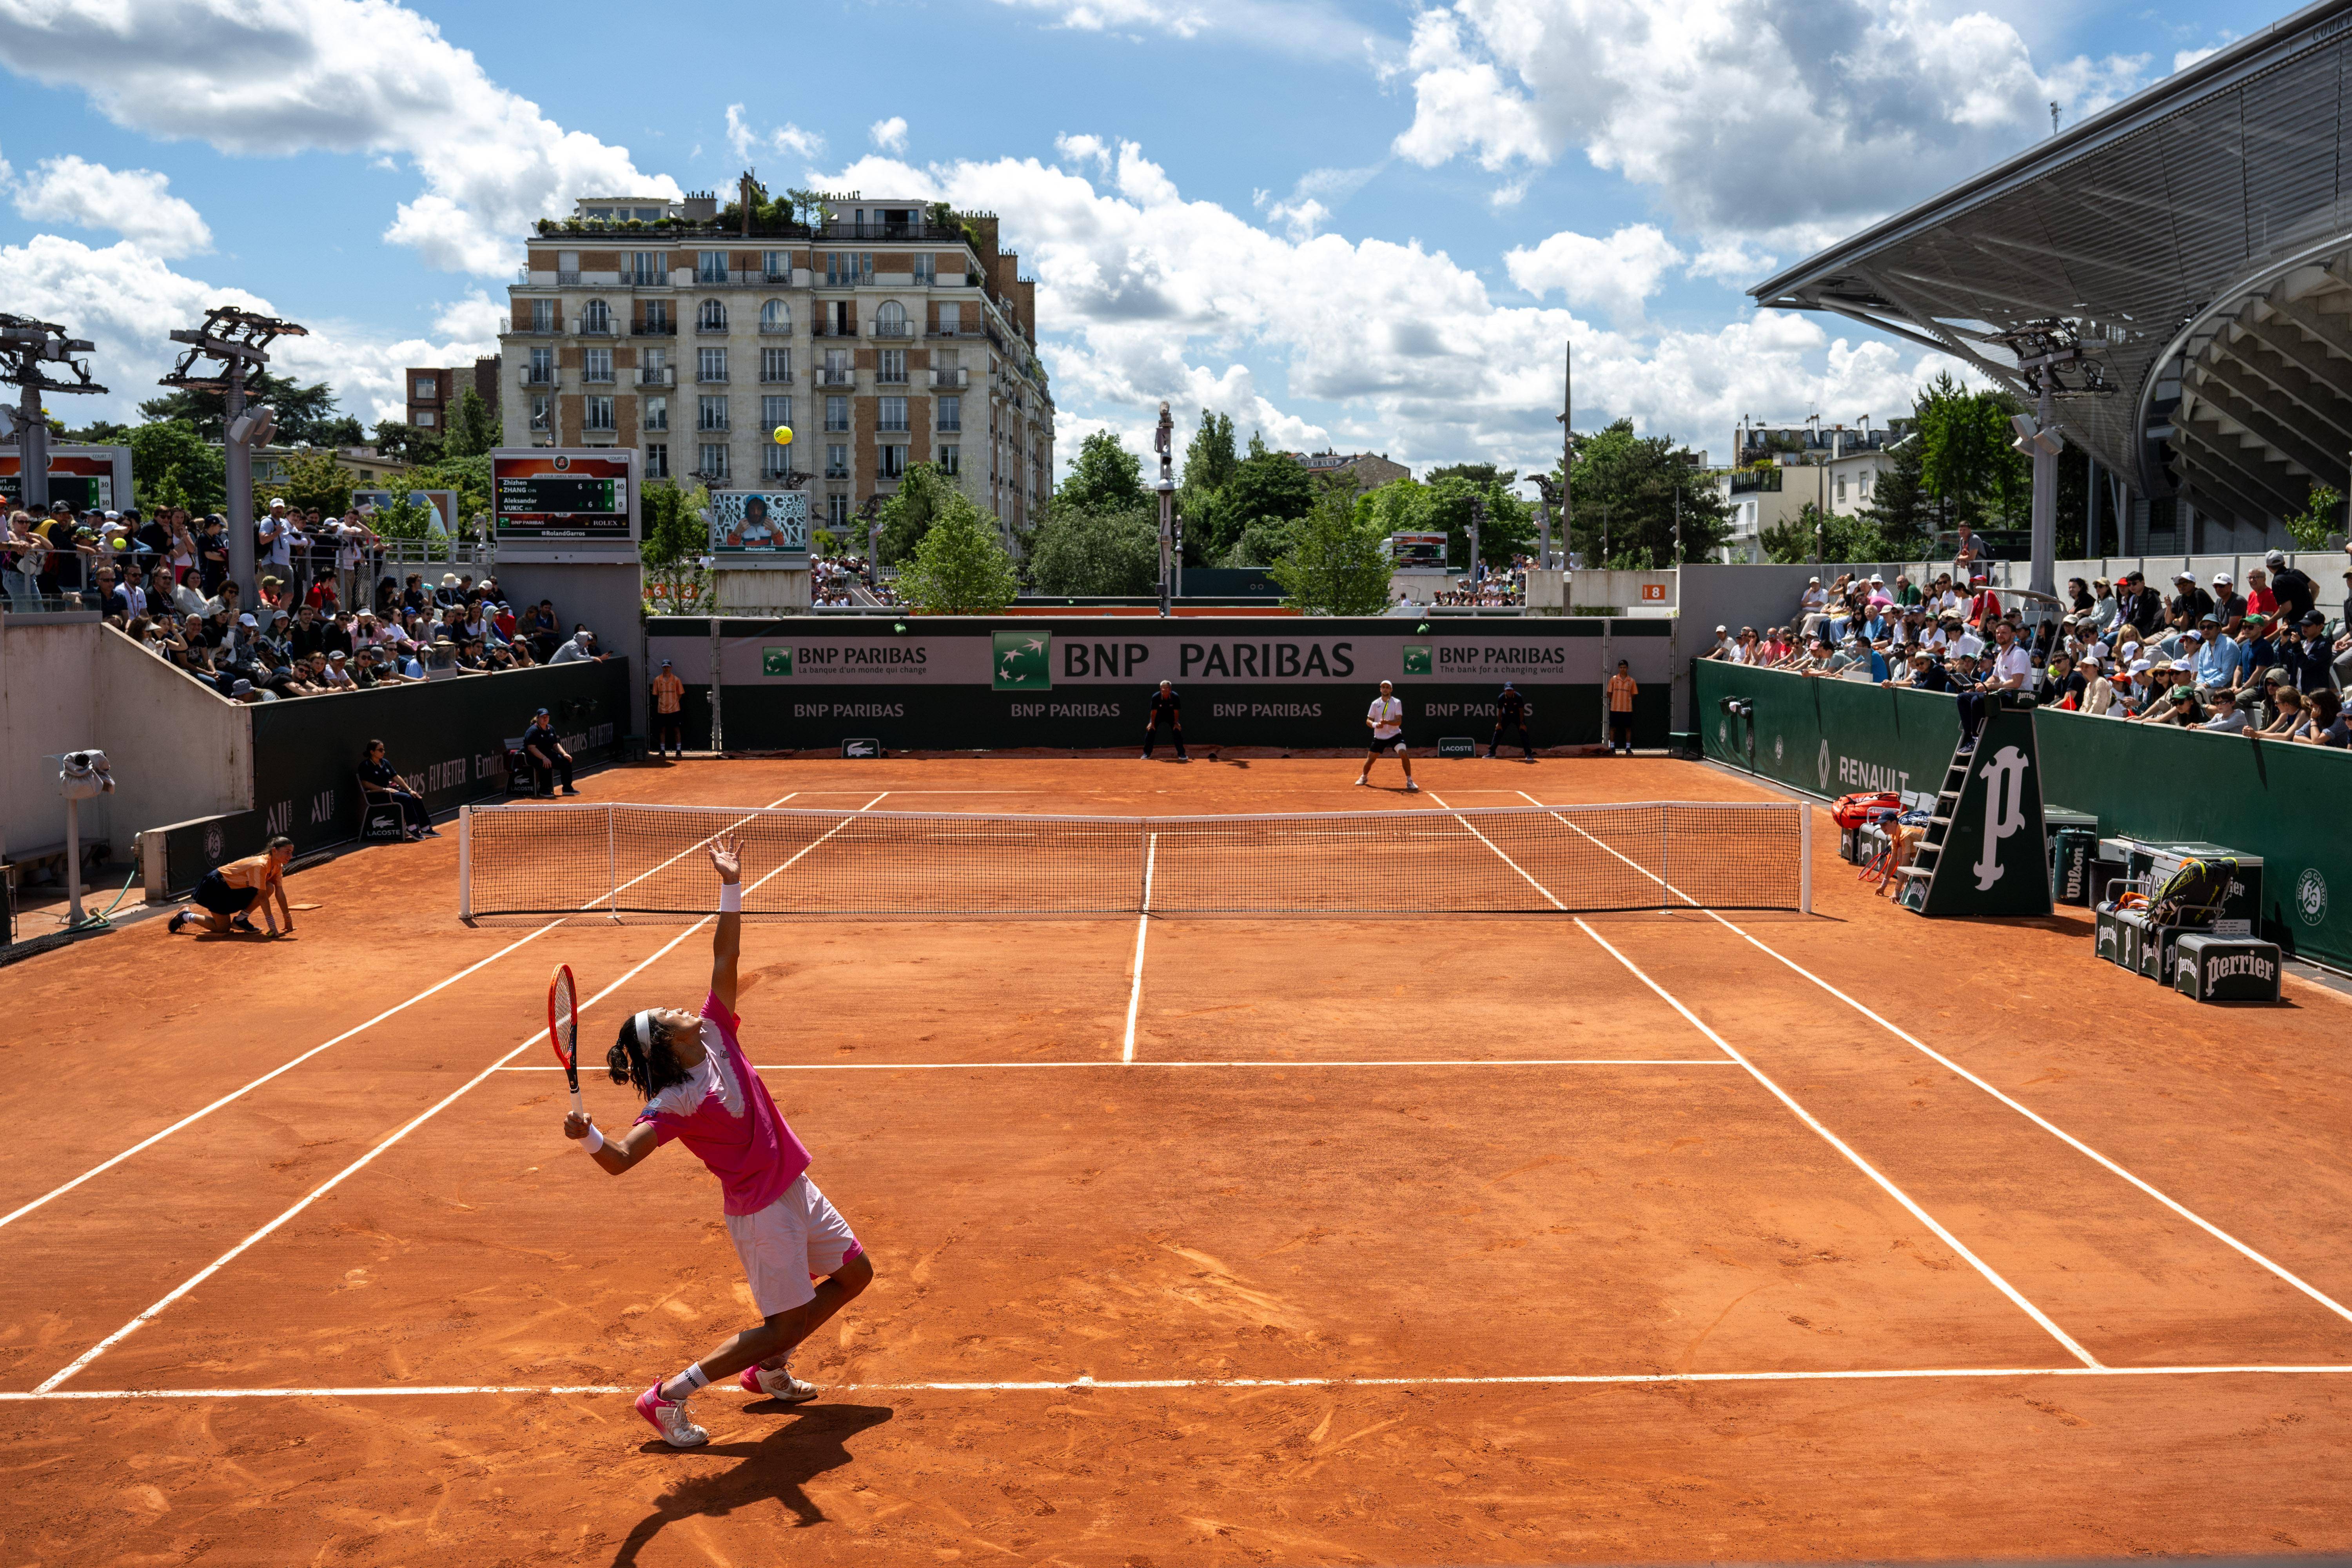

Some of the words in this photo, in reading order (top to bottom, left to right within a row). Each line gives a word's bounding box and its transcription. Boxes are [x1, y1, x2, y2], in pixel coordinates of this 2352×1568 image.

[654, 586, 662, 596] 6
[1652, 586, 1660, 598] 8
[799, 648, 839, 664] BNP
[844, 647, 927, 664] PARIBAS
[1064, 643, 1149, 677] BNP
[1180, 642, 1354, 677] PARIBAS
[1440, 648, 1479, 663] BNP
[1485, 647, 1565, 664] PARIBAS
[809, 666, 837, 675] banque
[886, 666, 897, 675] qui
[900, 666, 927, 675] change
[1479, 666, 1490, 675] for
[1501, 666, 1538, 675] changing
[794, 704, 829, 717] BNP
[833, 704, 904, 717] PARIBAS
[1011, 704, 1045, 717] BNP
[1050, 704, 1120, 717] PARIBAS
[1213, 704, 1247, 717] BNP
[1252, 704, 1322, 717] PARIBAS
[1425, 704, 1459, 716] BNP
[598, 722, 613, 746] BETTER
[430, 763, 441, 792] FLY
[442, 758, 466, 788] BETTER
[1839, 756, 1909, 793] RENAULT
[2067, 845, 2084, 898] Wilson
[2298, 872, 2312, 900] ROLAND
[2313, 873, 2326, 907] GARROS
[2301, 908, 2321, 922] PARIS
[2205, 949, 2274, 996] perrier
